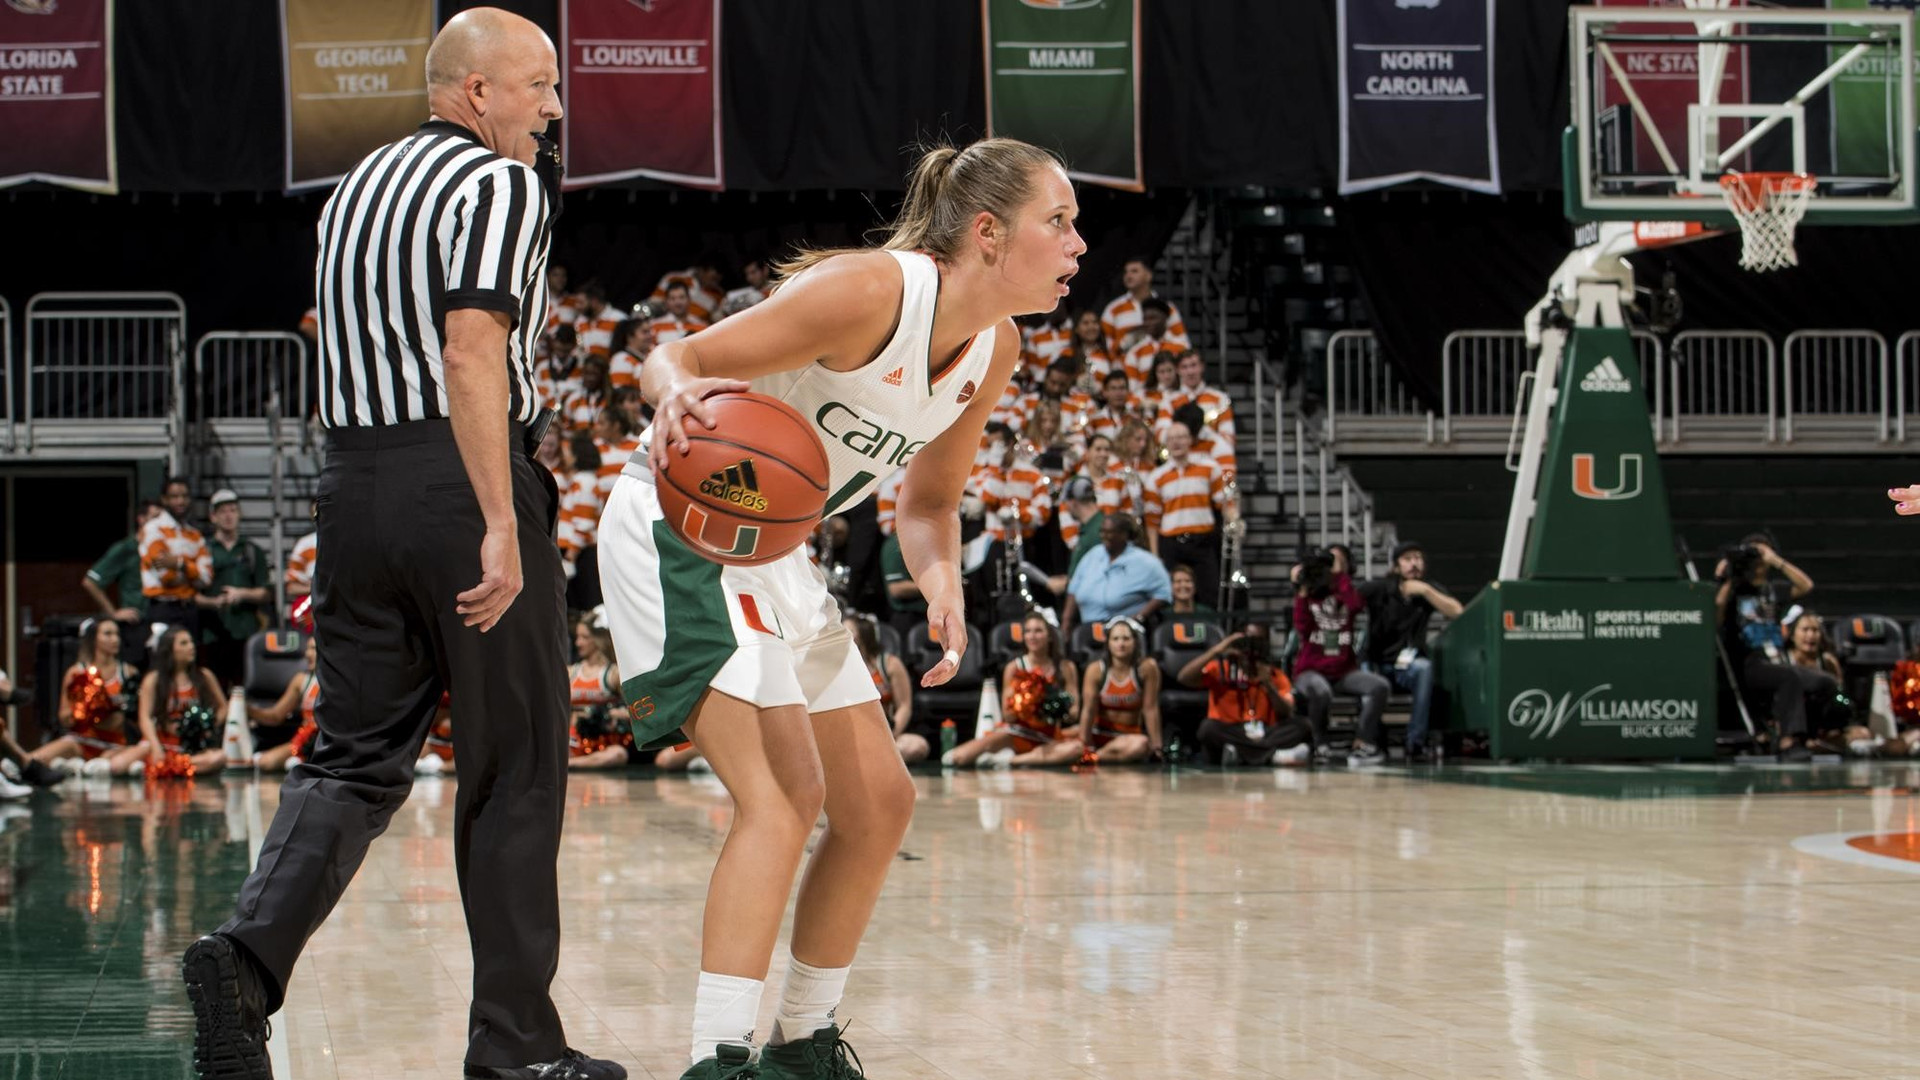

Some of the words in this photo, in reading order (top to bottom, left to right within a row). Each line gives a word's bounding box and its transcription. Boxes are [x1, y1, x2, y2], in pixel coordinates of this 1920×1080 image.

[0, 49, 78, 69] LORIDA
[314, 46, 408, 68] GEORGIA
[582, 46, 699, 66] LOUISVILLE
[1028, 48, 1095, 68] MIAMI
[1380, 51, 1454, 70] NORTH
[1627, 53, 1657, 72] NC
[1659, 53, 1699, 72] STA
[1, 74, 64, 95] STATE
[336, 73, 390, 92] TECH
[1366, 75, 1470, 95] CAROLINA
[1580, 379, 1632, 392] adidas
[816, 401, 927, 467] Cane
[1572, 453, 1643, 500] U
[699, 478, 769, 513] adidas
[682, 503, 761, 558] U
[1594, 610, 1642, 625] SPORTS
[1643, 610, 1703, 625] MEDICINE
[1594, 624, 1661, 639] INSTITUTE
[1620, 725, 1663, 738] BUICK
[1663, 725, 1697, 738] GMC
